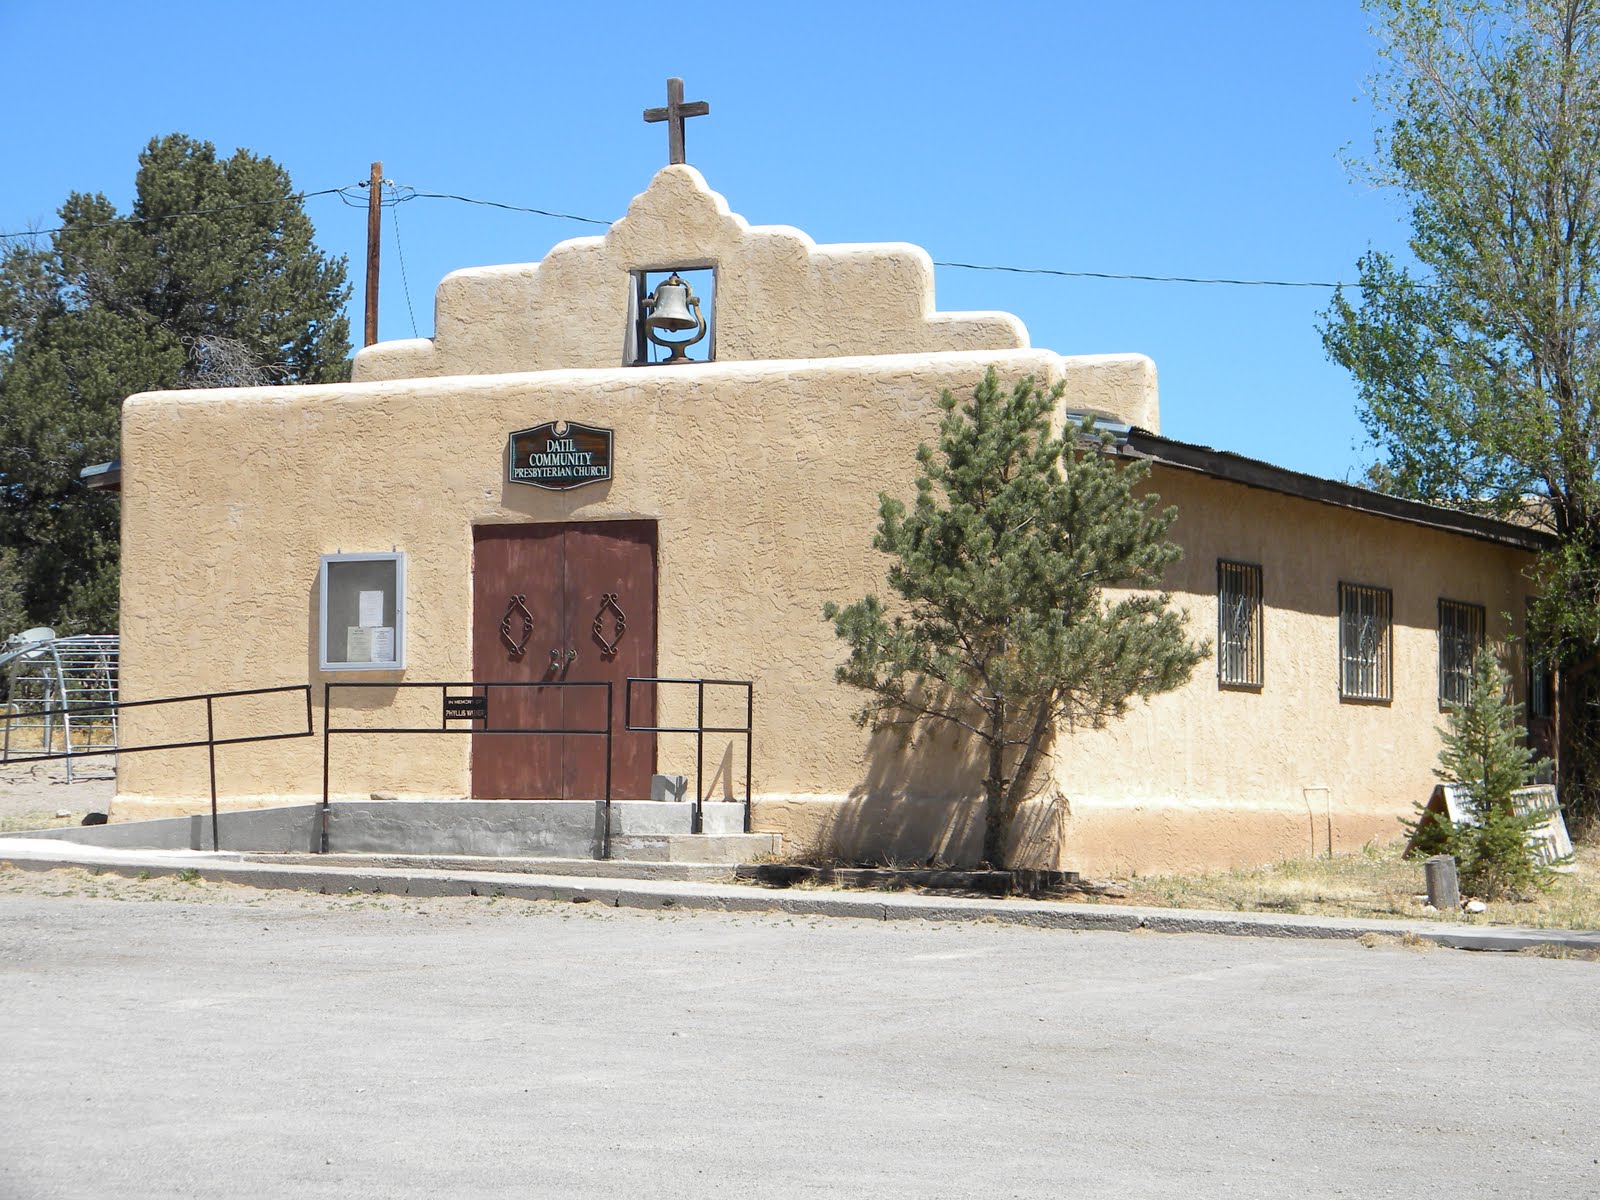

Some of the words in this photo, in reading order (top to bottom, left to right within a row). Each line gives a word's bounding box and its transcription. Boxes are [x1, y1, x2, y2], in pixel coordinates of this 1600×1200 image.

[546, 439, 576, 453] DATIL
[529, 452, 592, 467] COMMUNITY
[514, 467, 571, 478] PRESBYTERIAN
[573, 465, 607, 476] CHURCH
